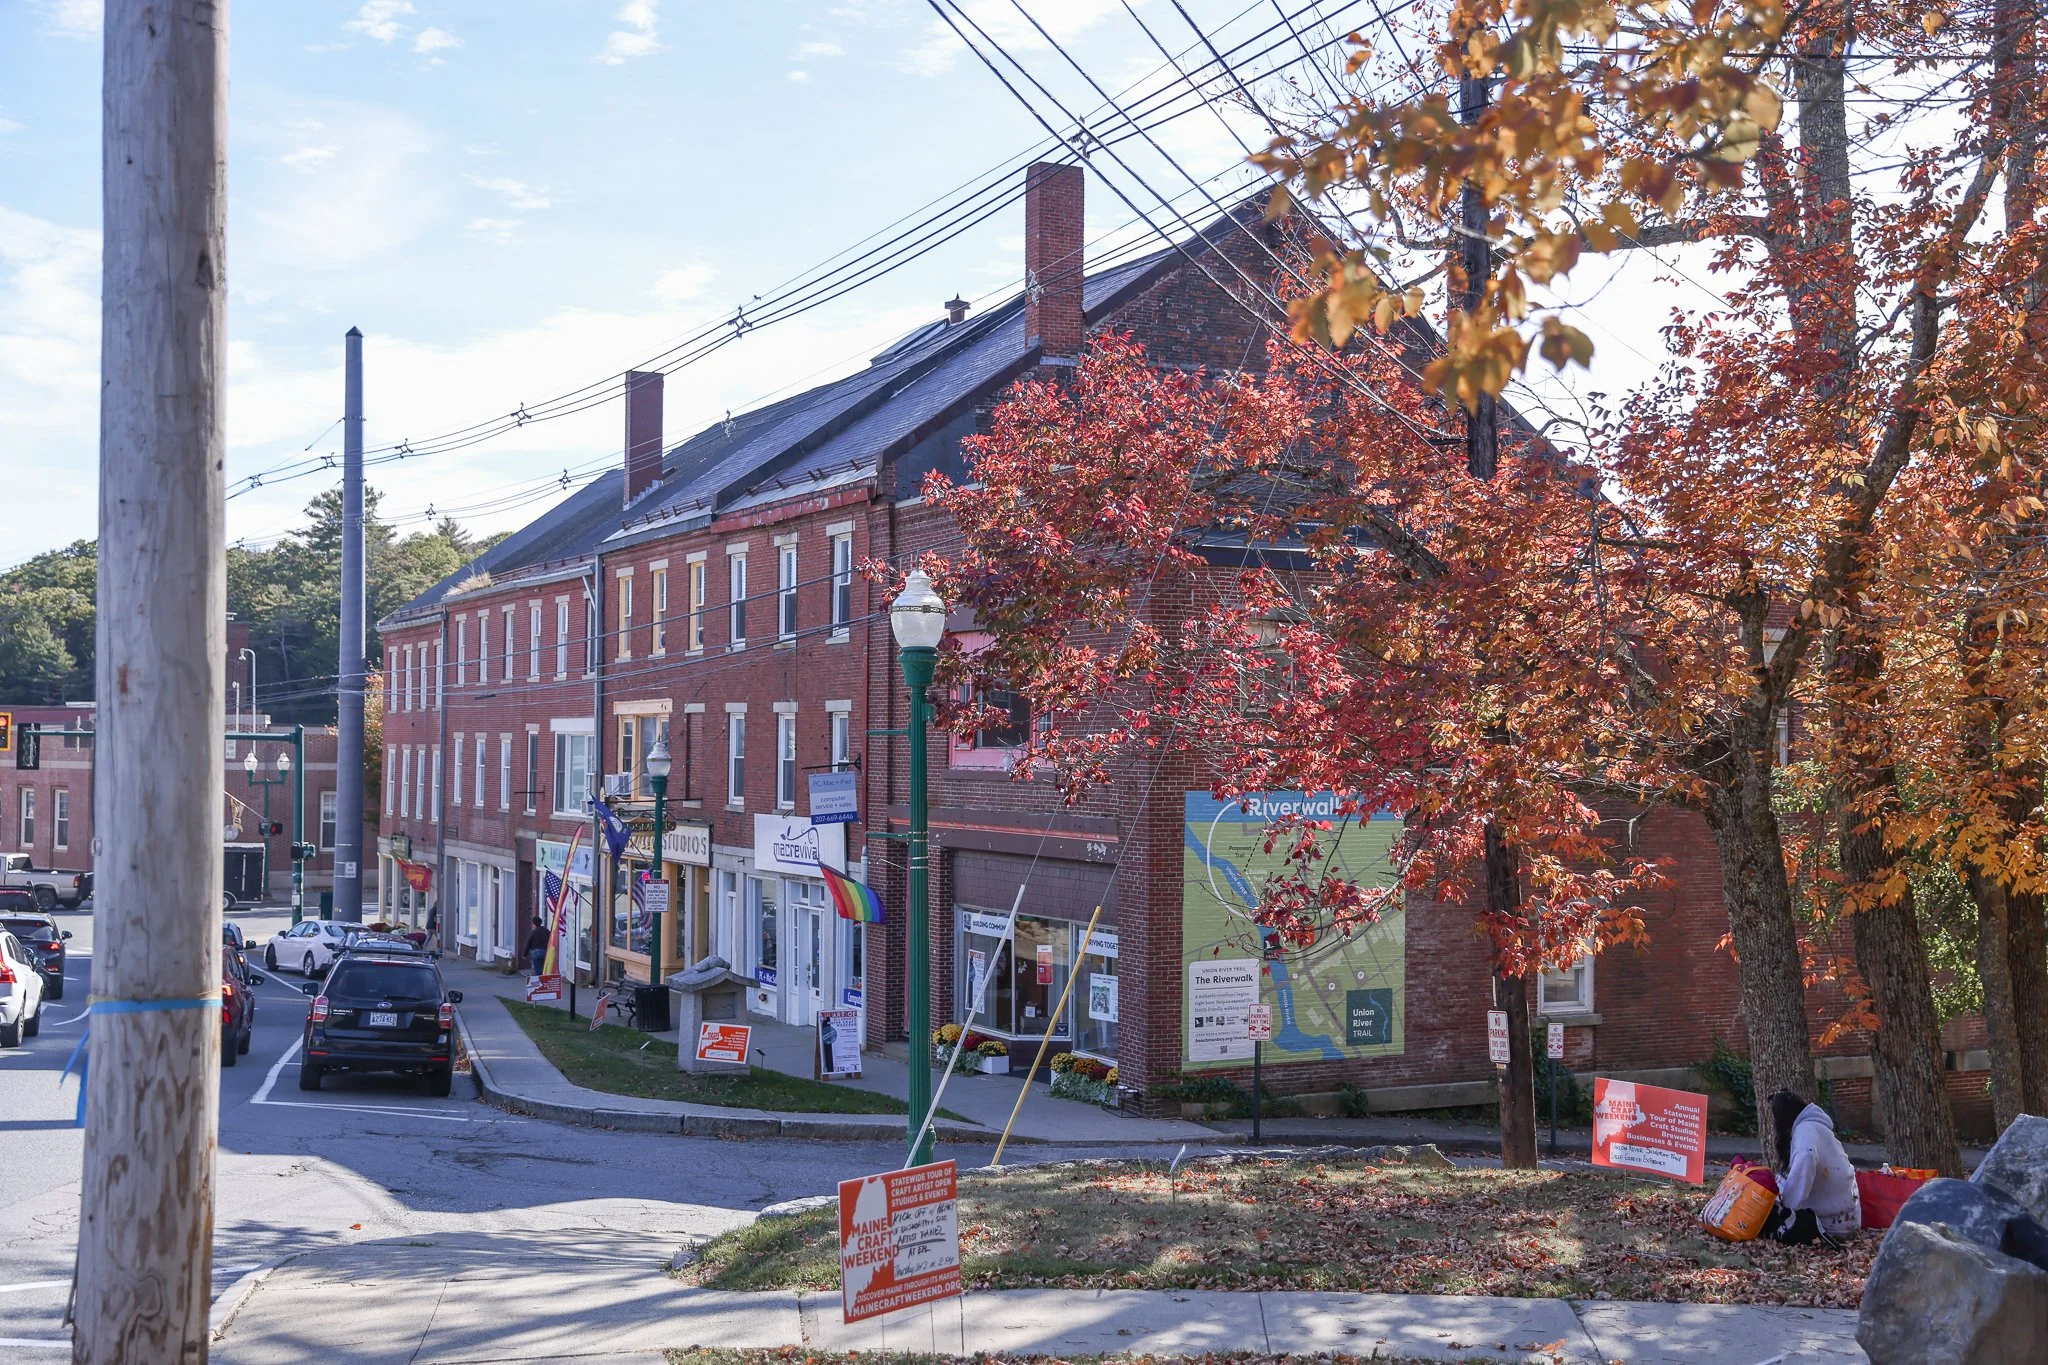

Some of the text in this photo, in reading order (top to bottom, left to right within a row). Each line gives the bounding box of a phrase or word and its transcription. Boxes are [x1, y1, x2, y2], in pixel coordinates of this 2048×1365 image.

[815, 813, 853, 822] 207-669-6446
[1213, 974, 1253, 984] Riverwalk
[1495, 1017, 1501, 1026] NO
[1490, 1029, 1506, 1038] PARKING
[1664, 1109, 1699, 1121] Statewide
[1675, 1103, 1699, 1113] Annual
[1596, 1112, 1638, 1121] WEEKEND
[1649, 1114, 1666, 1122] Tour
[1678, 1119, 1699, 1128] Maine
[1650, 1121, 1699, 1137] Craft Studios,
[1627, 1132, 1665, 1145] Businesses
[1675, 1142, 1698, 1151] Events
[1662, 1131, 1698, 1145] Breweries,
[891, 1168, 952, 1187] STATEWIDE TOUR OF
[892, 1178, 951, 1197] CRAFT ARTIST OPEN
[892, 1195, 918, 1207] STUDIOS
[924, 1188, 948, 1200] EVENTS
[893, 1211, 912, 1225] KICK
[915, 1207, 928, 1218] OFF
[850, 1218, 887, 1238] MAINE
[920, 1226, 946, 1239] PANEL
[858, 1231, 893, 1250] CRAFT
[844, 1244, 899, 1269] WEEKEND
[938, 1257, 944, 1266] 2
[857, 1289, 885, 1302] DISCOVER
[886, 1284, 903, 1296] MAINE
[904, 1279, 930, 1291] THROUGH
[939, 1270, 959, 1281] MAKERS
[853, 1281, 960, 1317] MAINECRAFTWEEKEND.ORG
